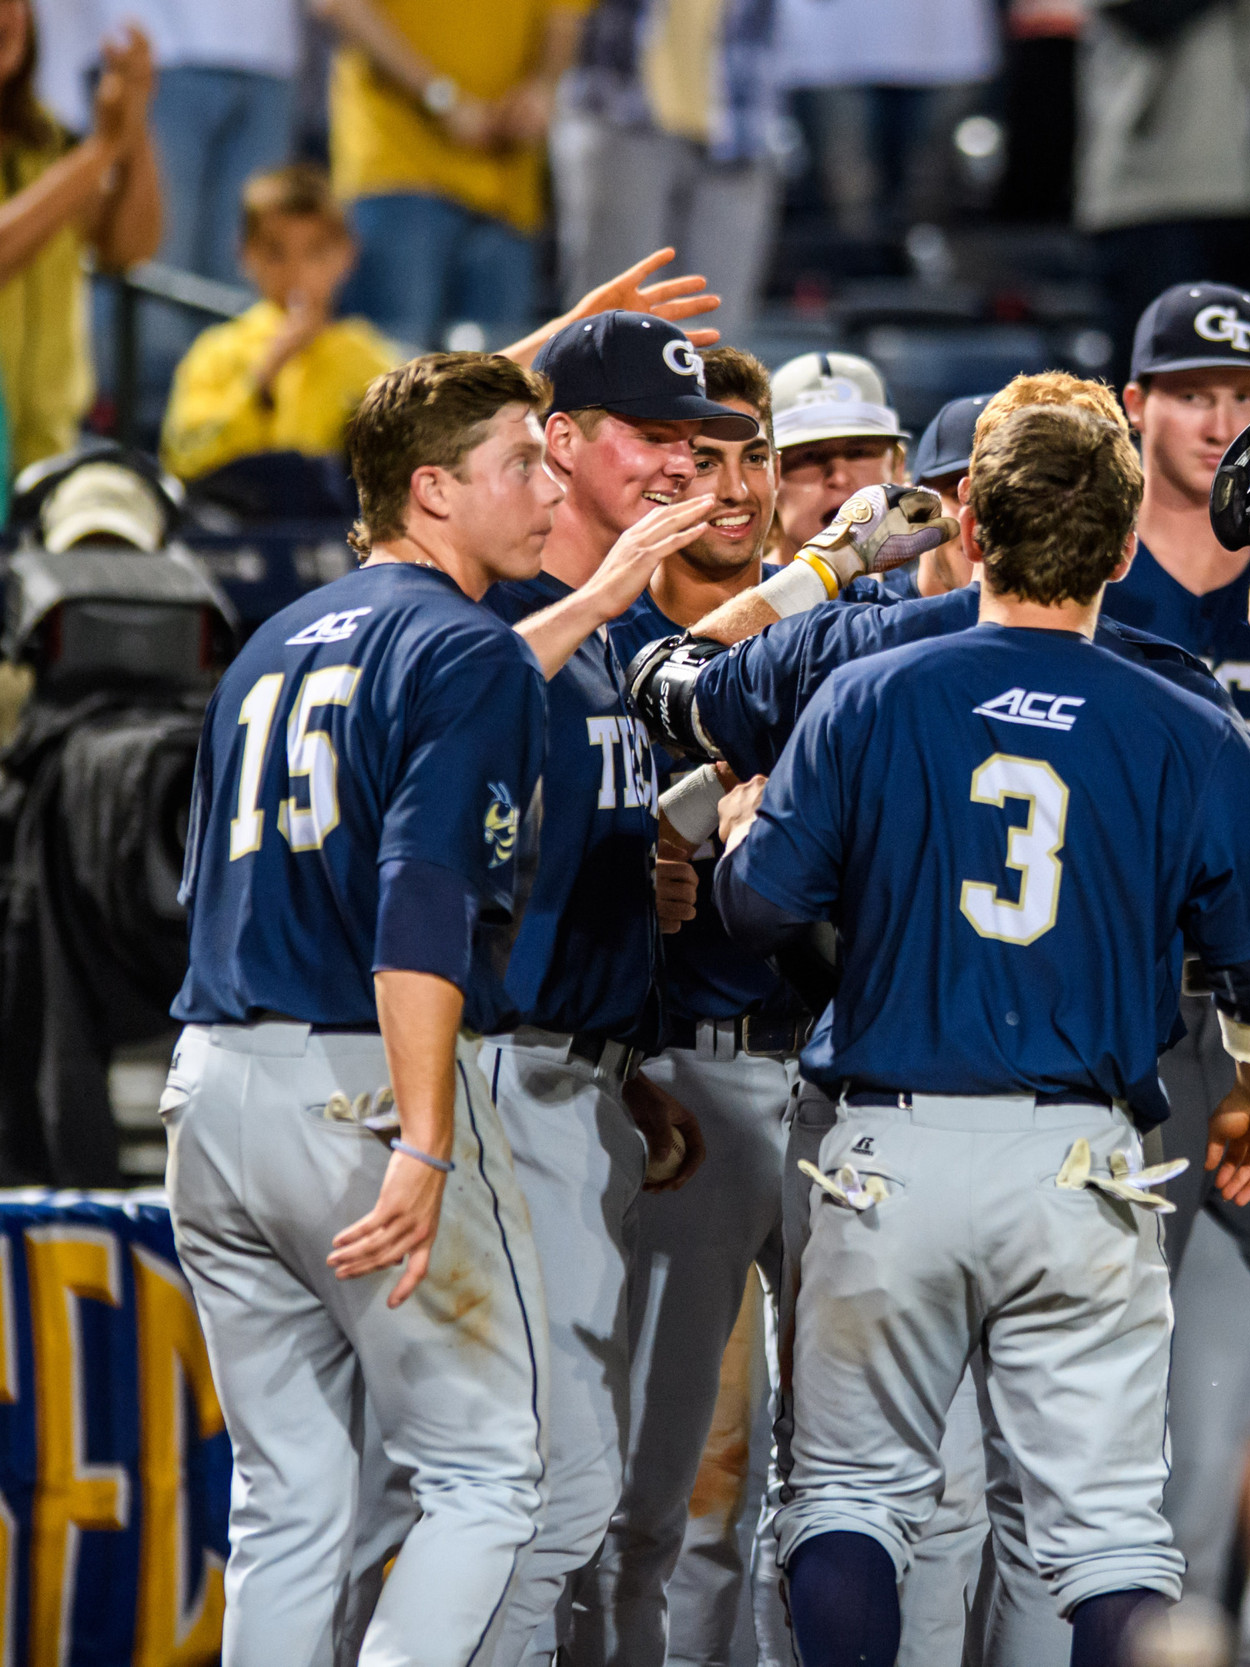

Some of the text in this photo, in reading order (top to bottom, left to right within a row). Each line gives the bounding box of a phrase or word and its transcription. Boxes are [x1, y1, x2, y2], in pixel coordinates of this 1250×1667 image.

[284, 606, 373, 646] ACC
[229, 664, 363, 862] 15
[972, 687, 1087, 732] ACC
[959, 752, 1070, 947] 3
